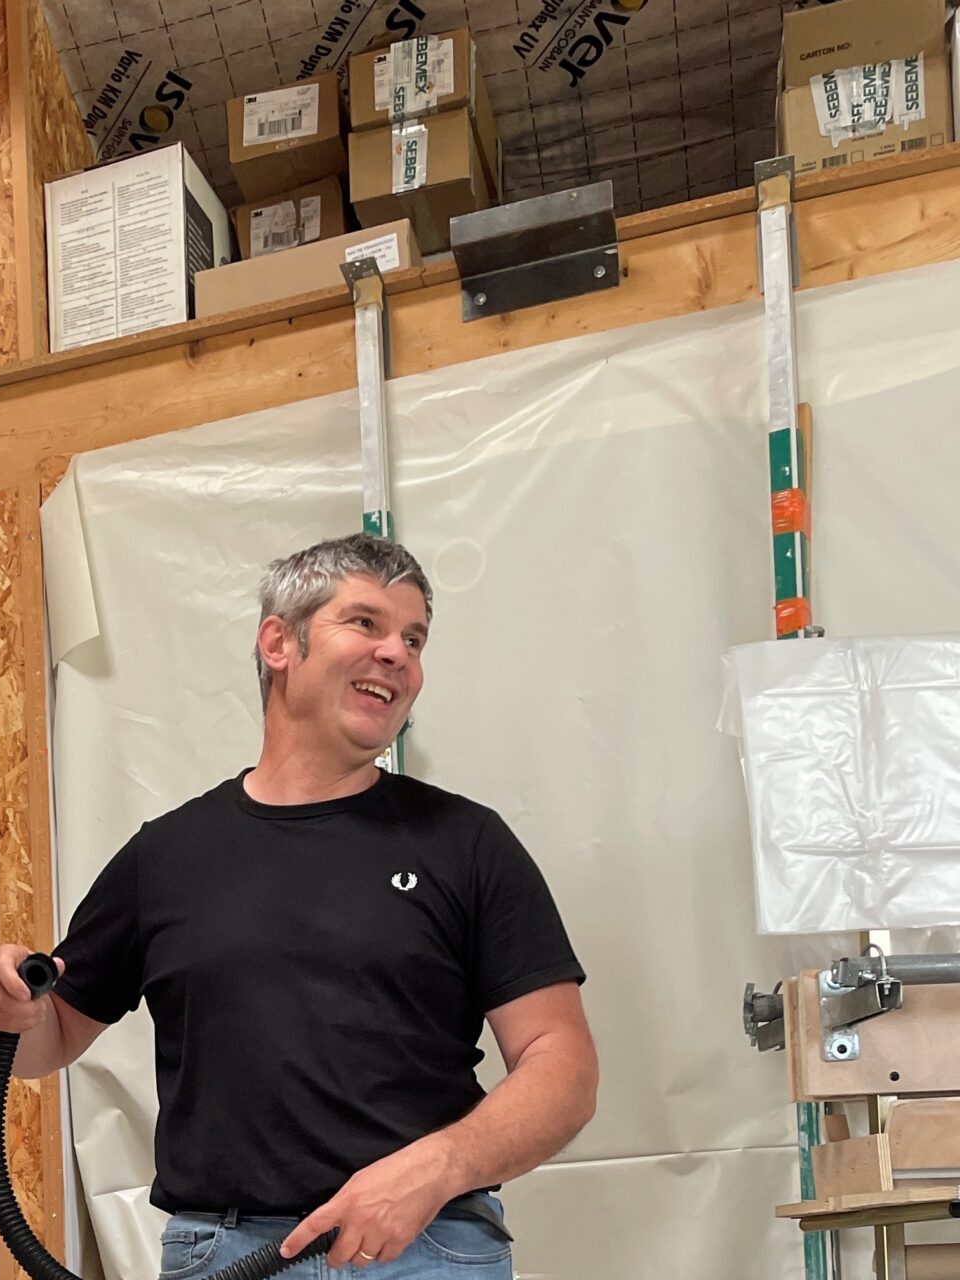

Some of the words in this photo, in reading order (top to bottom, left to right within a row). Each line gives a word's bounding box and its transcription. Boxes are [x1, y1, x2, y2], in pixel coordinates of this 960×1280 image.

[513, 32, 539, 60] UV
[800, 46, 835, 61] CARTON
[110, 50, 143, 83] Vario
[415, 35, 428, 97] EBEMEX
[98, 119, 132, 161] SAINT-GO
